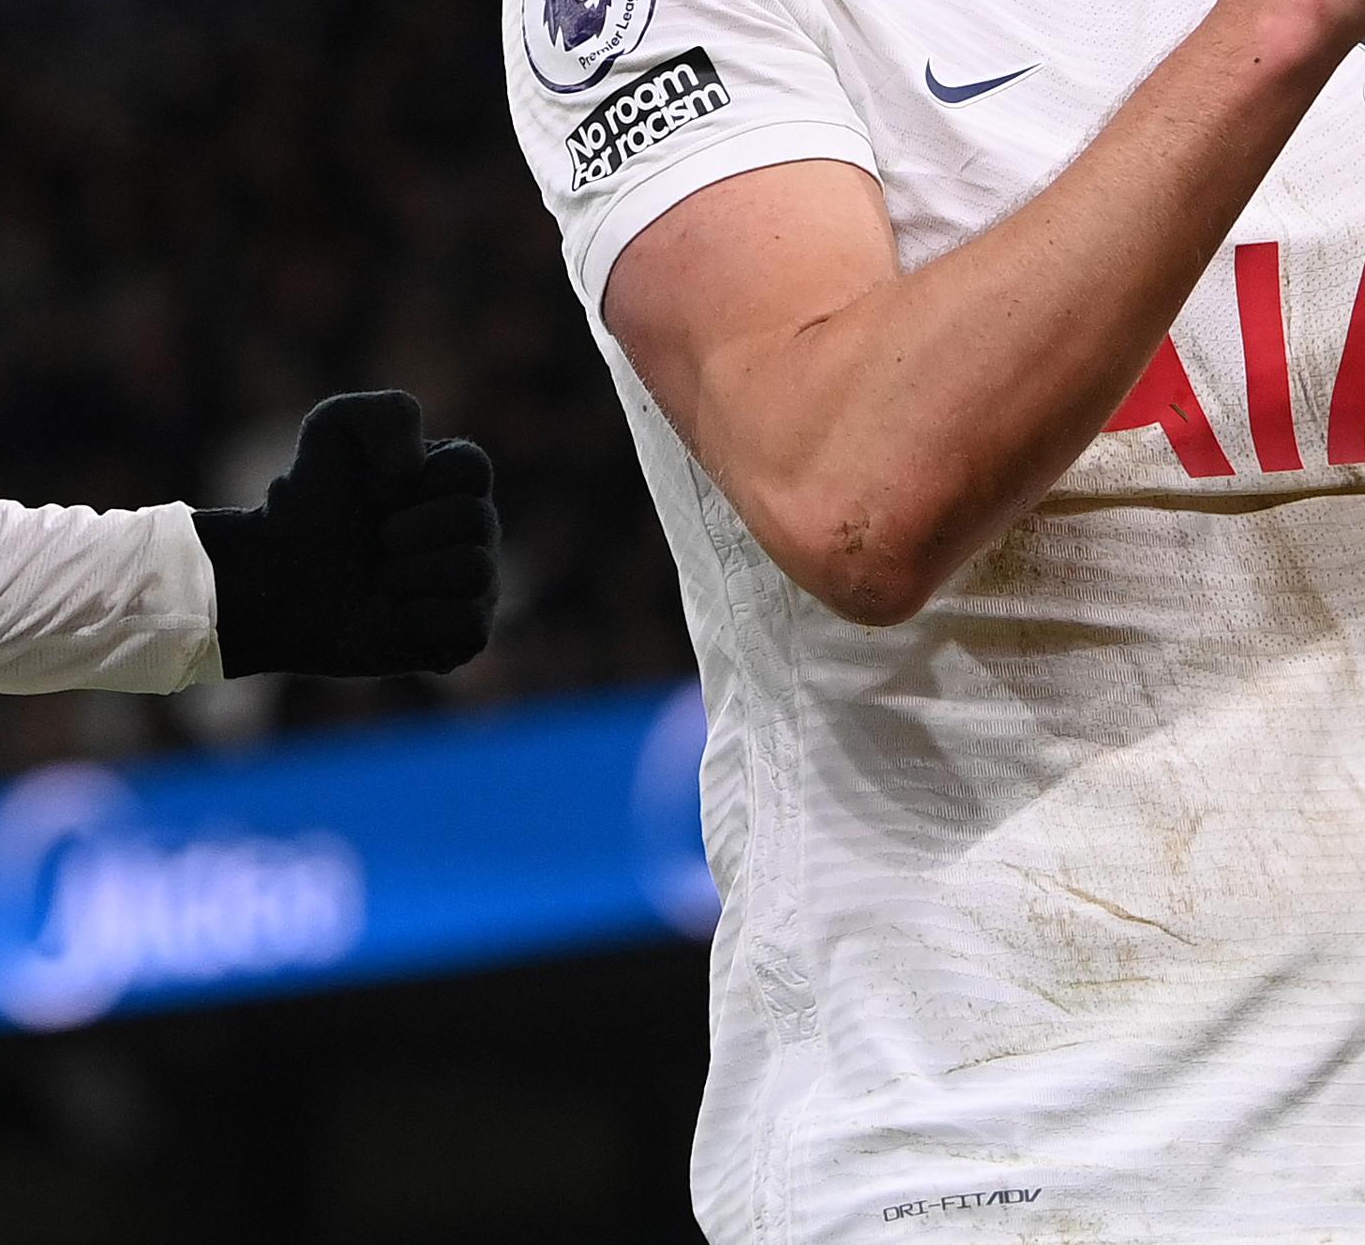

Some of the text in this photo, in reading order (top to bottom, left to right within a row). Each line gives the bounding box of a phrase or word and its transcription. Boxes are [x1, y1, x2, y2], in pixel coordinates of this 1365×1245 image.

[578, 30, 623, 70] Premier
[567, 63, 700, 170] No room
[614, 82, 729, 164] racism
